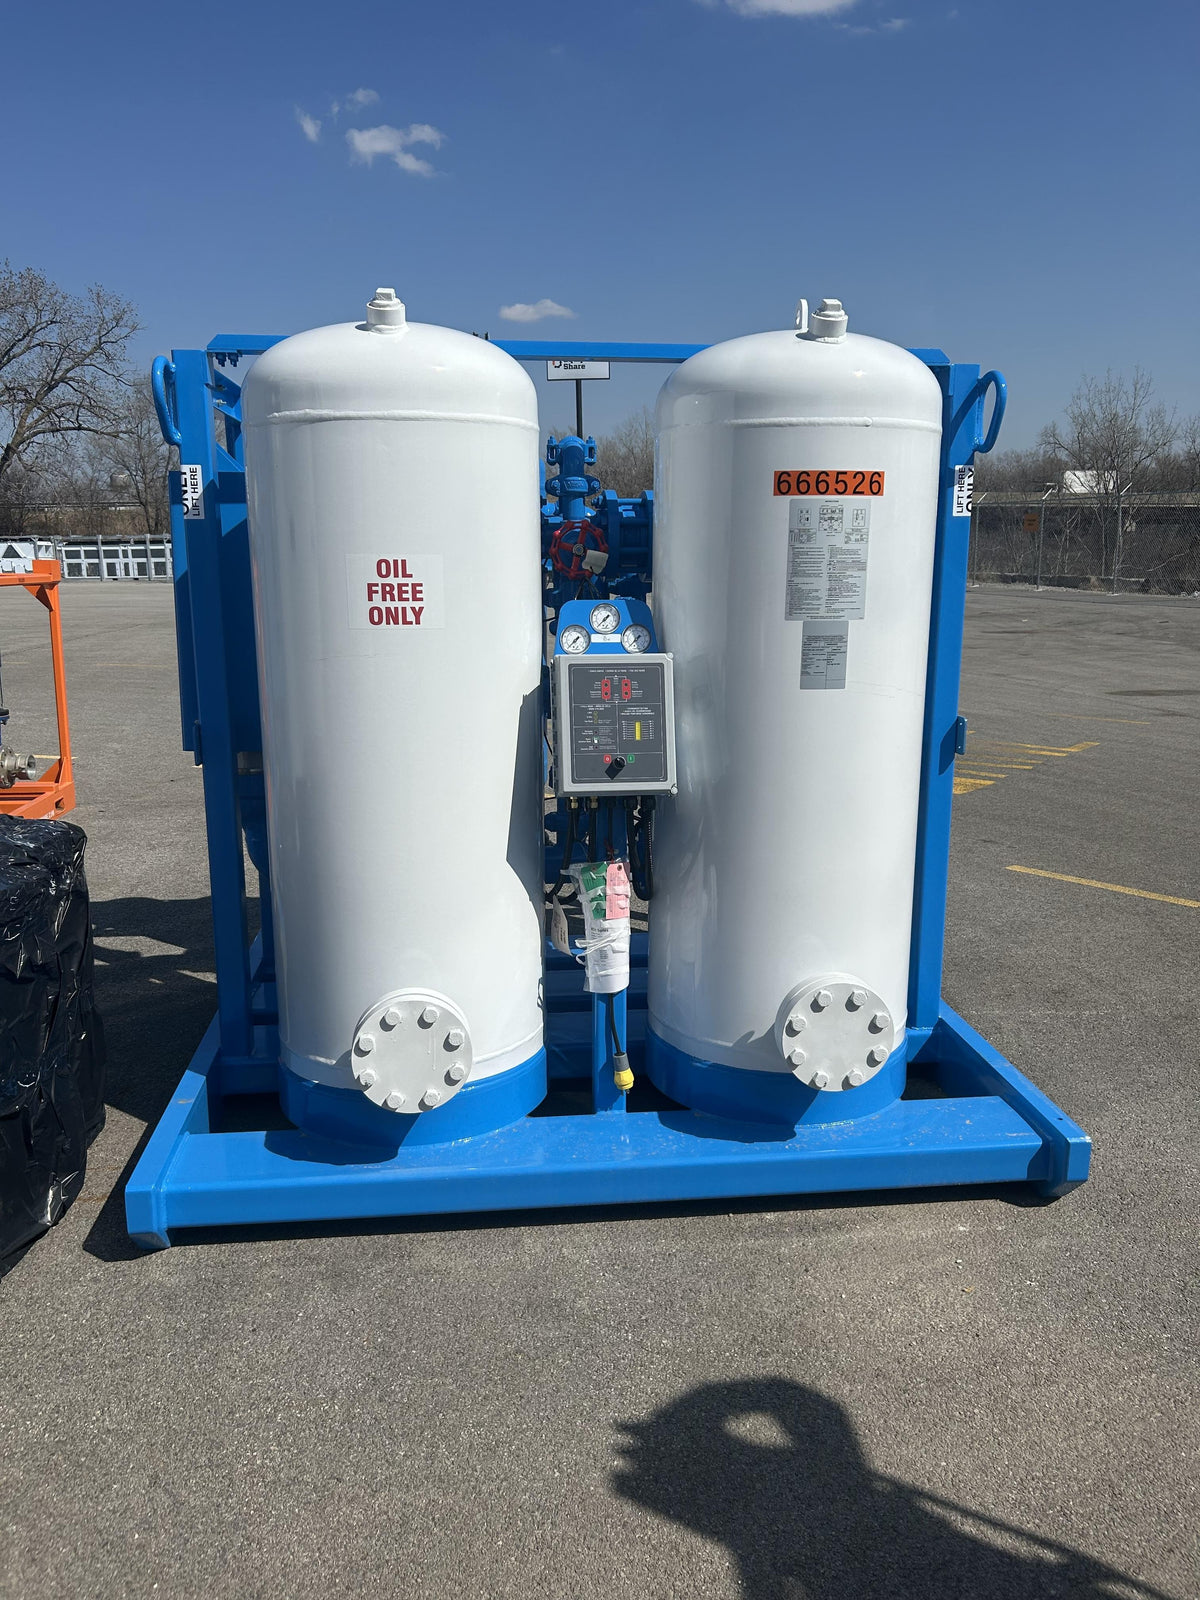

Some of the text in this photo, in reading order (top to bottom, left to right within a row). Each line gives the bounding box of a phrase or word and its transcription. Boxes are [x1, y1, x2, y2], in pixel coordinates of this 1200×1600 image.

[190, 467, 200, 516] LIFT HERE
[776, 471, 882, 495] 666526
[376, 558, 413, 579] OIL
[366, 582, 424, 602] FREE
[368, 606, 425, 626] ONLY
